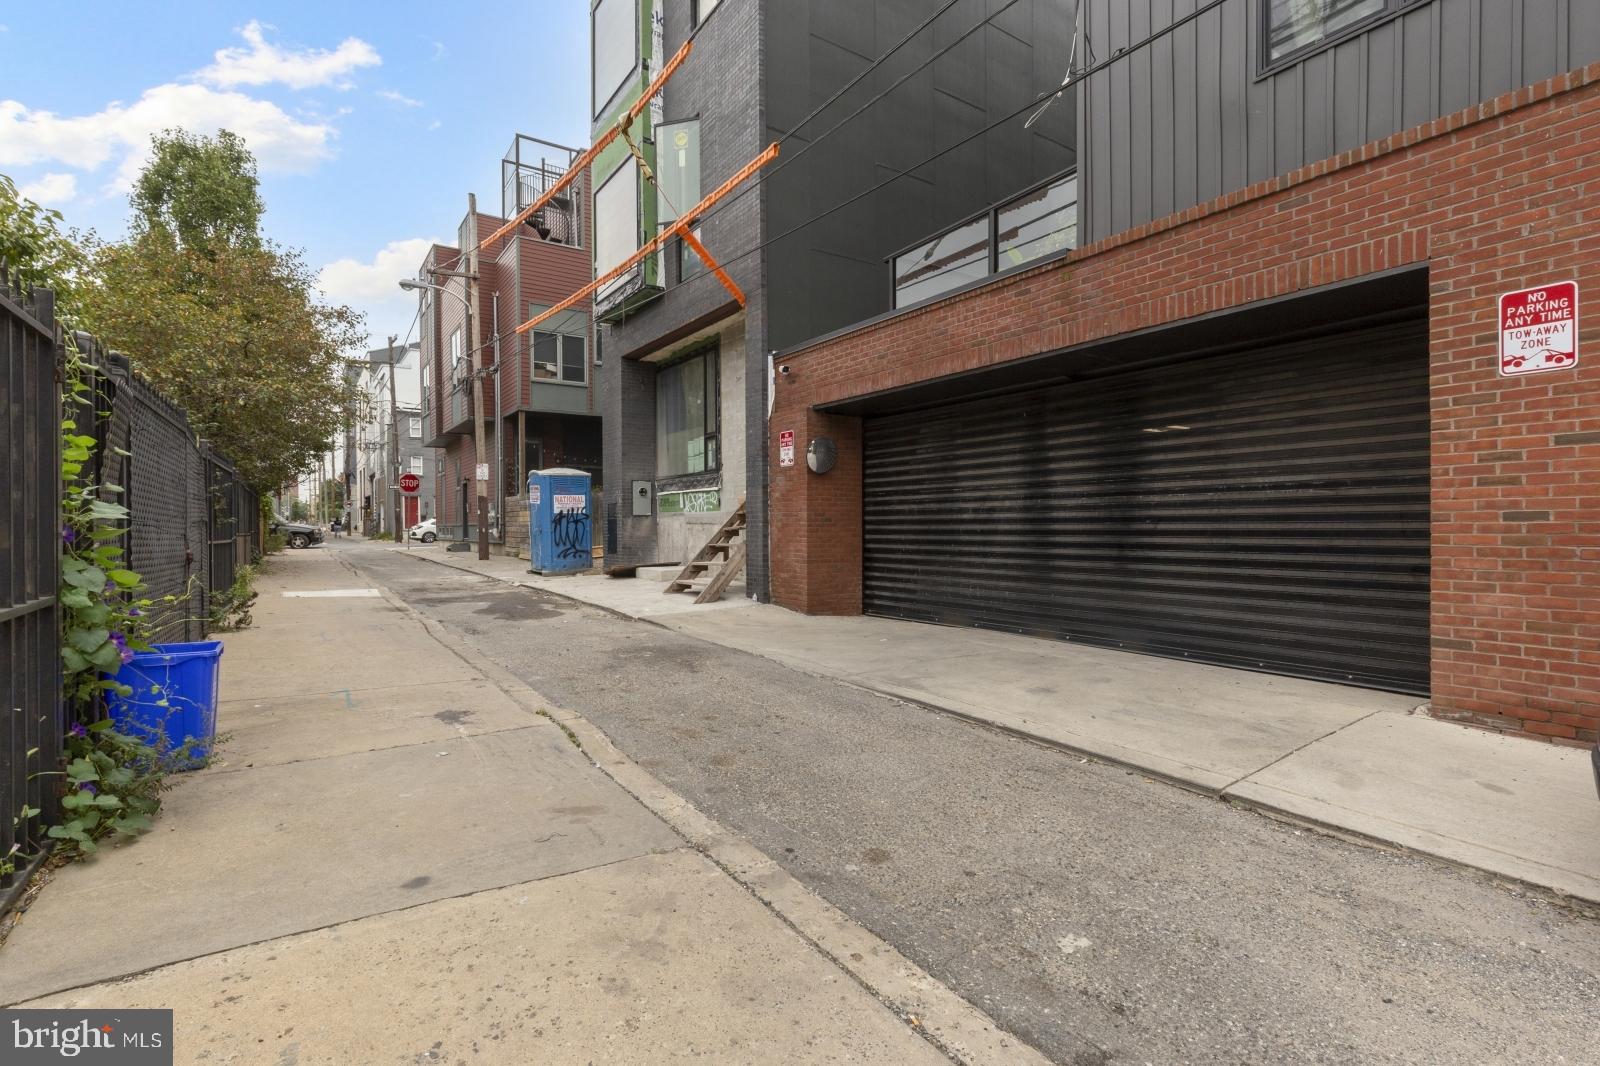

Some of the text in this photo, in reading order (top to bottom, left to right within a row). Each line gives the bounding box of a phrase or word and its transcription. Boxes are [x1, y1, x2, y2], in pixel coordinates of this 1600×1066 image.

[1528, 291, 1546, 303] NO
[1507, 298, 1569, 317] PARKING
[1505, 308, 1572, 328] ANY TIME
[1509, 323, 1567, 341] TOW-AWAY
[1521, 337, 1551, 350] ZONE
[400, 479, 419, 488] STOP
[555, 495, 584, 503] NATIONAL
